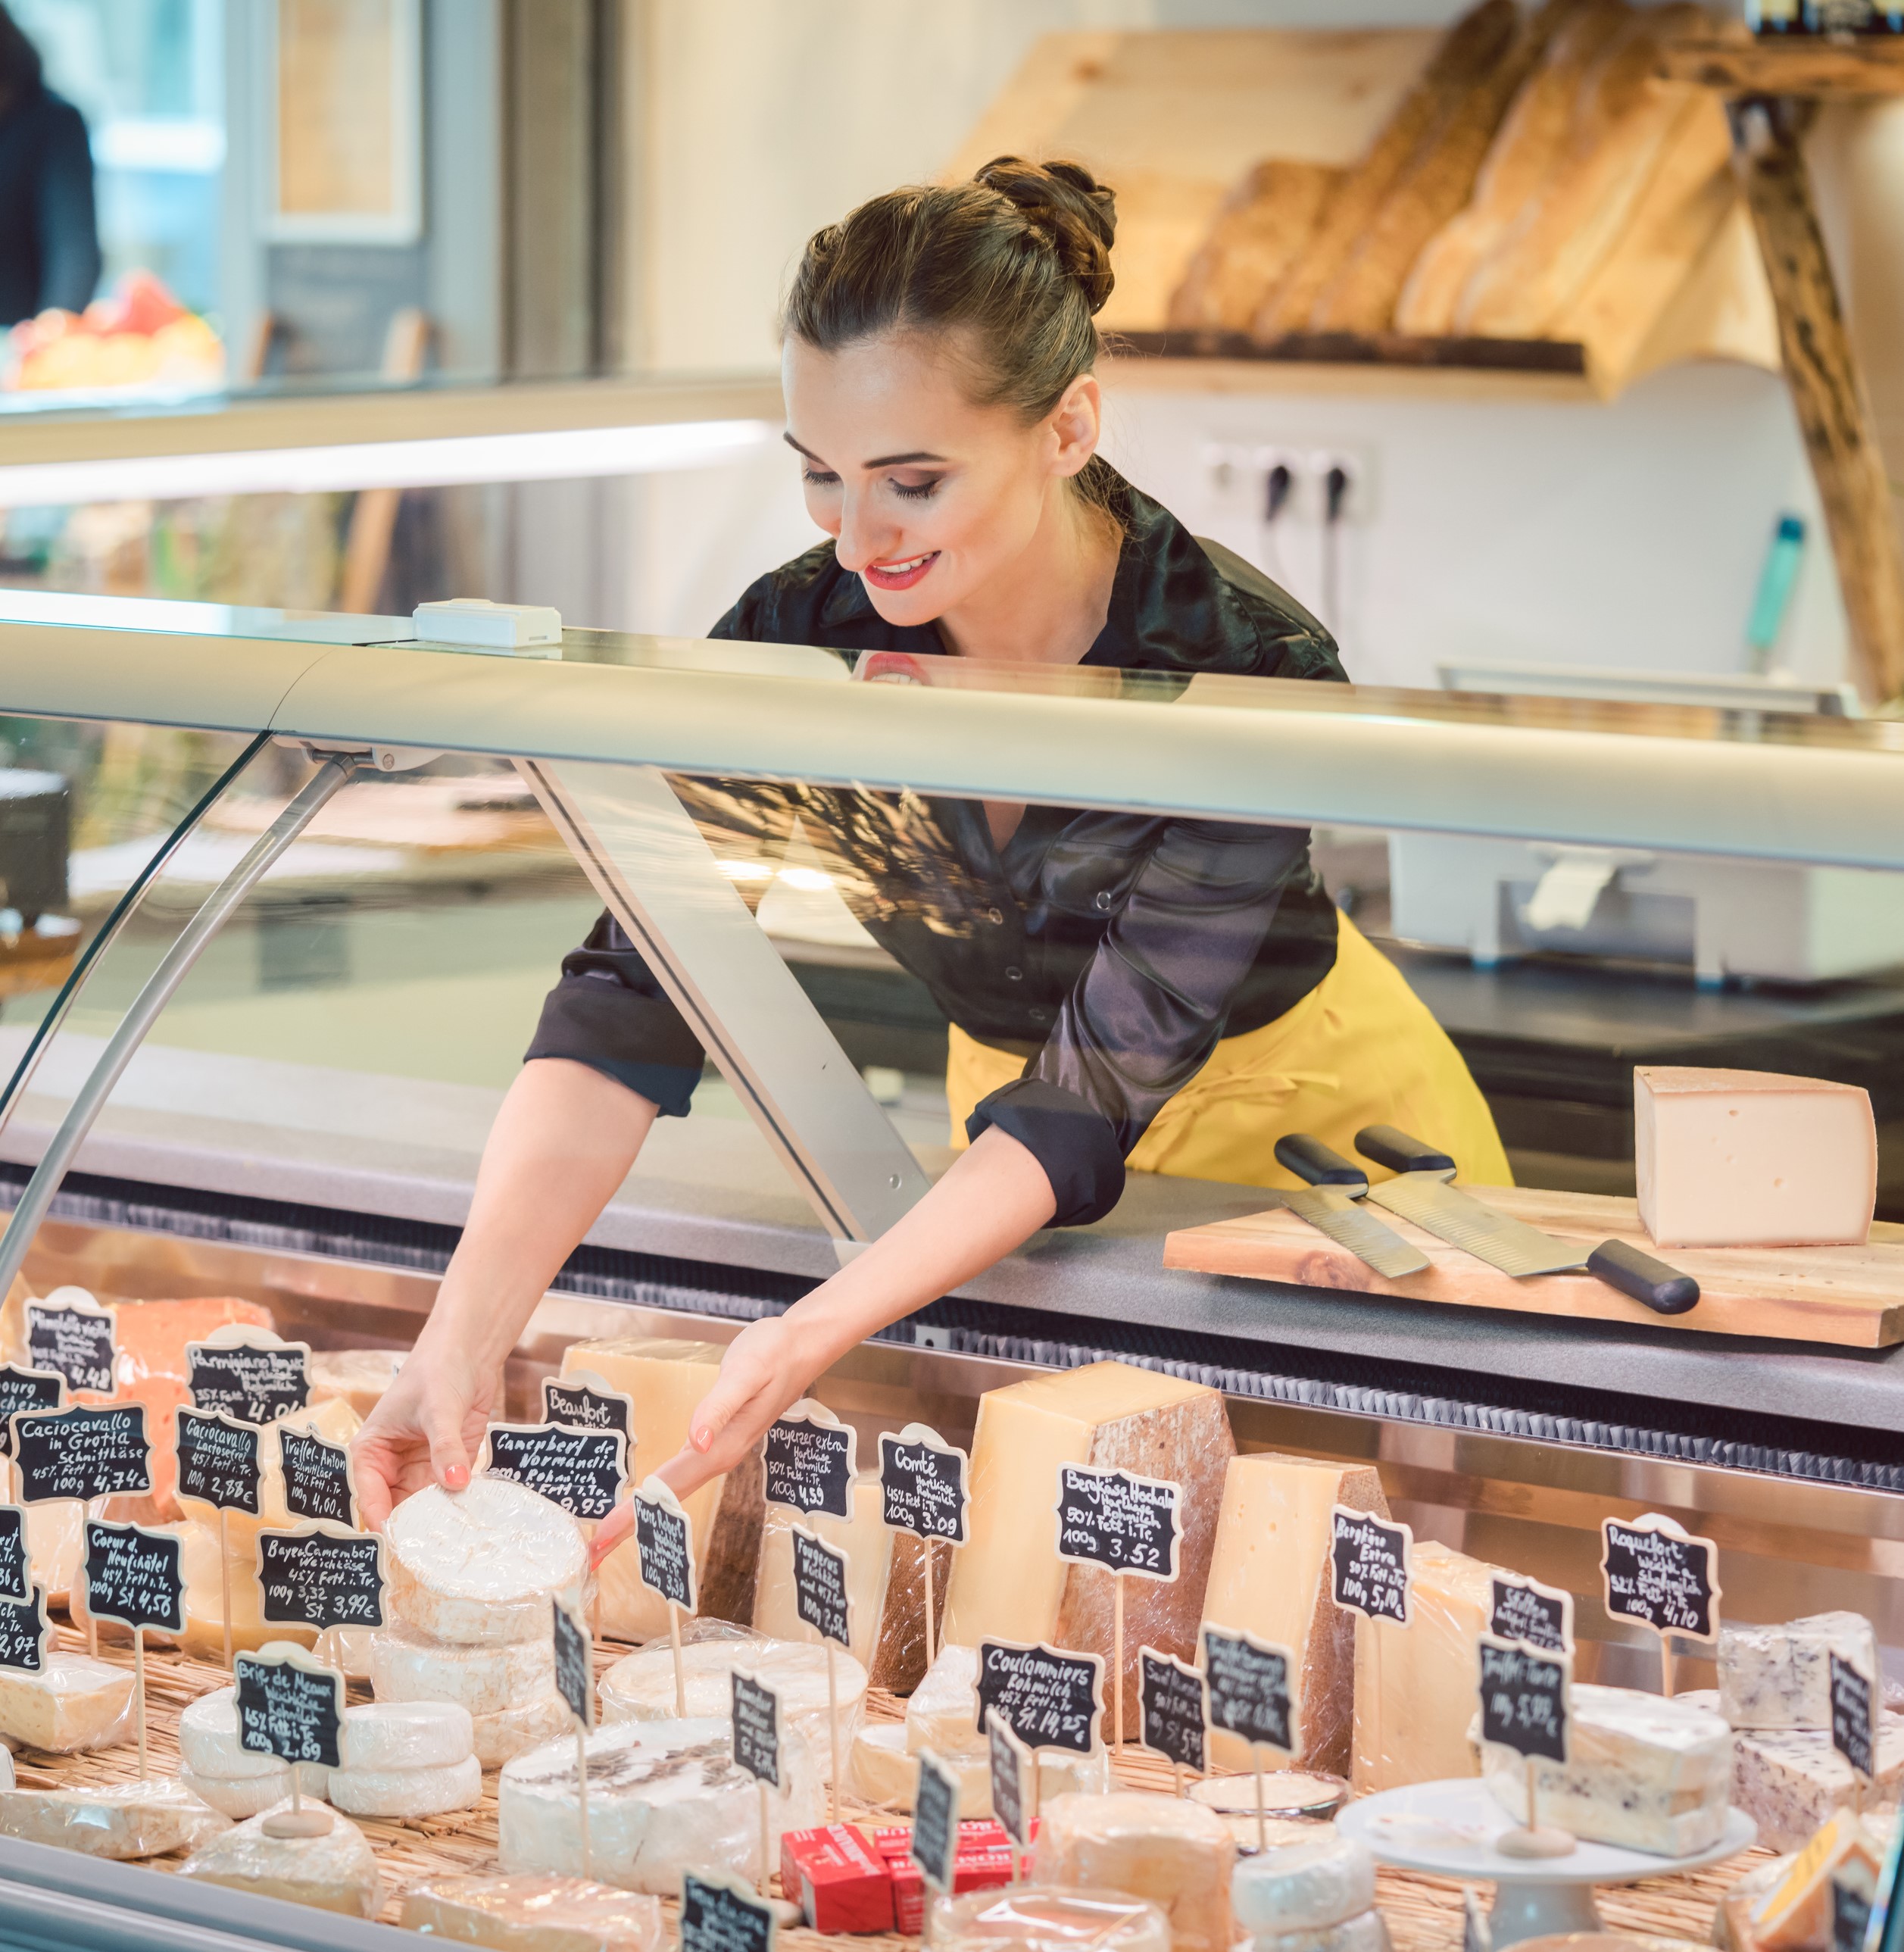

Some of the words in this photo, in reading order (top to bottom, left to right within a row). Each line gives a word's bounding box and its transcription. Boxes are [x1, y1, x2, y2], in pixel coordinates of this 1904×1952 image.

[70, 1365, 111, 1390] 4.48
[0, 1381, 36, 1399] ourg
[550, 1388, 611, 1425] Beaufort
[22, 1412, 131, 1438] Caciocavallo
[186, 1418, 251, 1453] Caciocavallo
[49, 1438, 62, 1451] in
[68, 1432, 130, 1450] Grotta
[196, 1440, 247, 1463] Lactosefrei
[594, 1440, 615, 1454] de
[816, 1432, 847, 1452] extra
[58, 1447, 144, 1464] Schnittkäse
[192, 1452, 210, 1467] 45%
[211, 1457, 230, 1471] Fett
[240, 1464, 251, 1476] Tr.
[519, 1454, 616, 1471] Normandie
[794, 1446, 832, 1464] Hartkäse
[794, 1457, 832, 1473] Rohmilch
[895, 1446, 938, 1477] Comté
[32, 1465, 58, 1479] 45%
[61, 1463, 86, 1476] Fett
[292, 1457, 332, 1480] Schnittkäse
[525, 1469, 596, 1485] Rohmilch
[769, 1461, 785, 1476] 50%
[787, 1466, 804, 1481] Fett
[53, 1477, 84, 1495] 100g
[187, 1469, 204, 1493] 100g
[294, 1472, 308, 1486] 50%
[311, 1476, 325, 1490] Fett
[771, 1480, 796, 1504] 100g
[1066, 1469, 1127, 1504] Bergkäse
[292, 1486, 307, 1510] 100g
[887, 1485, 904, 1504] 45%
[906, 1492, 921, 1508] Fett
[916, 1485, 956, 1508] Rohmilch
[635, 1498, 657, 1528] Pierre
[657, 1508, 683, 1540] Robert
[886, 1504, 915, 1528] 100g
[922, 1511, 957, 1536] 3.09
[1066, 1507, 1095, 1527] 50%
[1096, 1514, 1125, 1535] Fett
[1103, 1504, 1162, 1529] Rohmilch
[92, 1529, 126, 1550] Coeur
[127, 1537, 138, 1554] d.
[1063, 1529, 1097, 1553] 100g
[1110, 1538, 1160, 1568] 3,52
[1608, 1526, 1683, 1561] Roquefort
[299, 1556, 366, 1572] Weichkäse
[1359, 1543, 1397, 1566] Extra
[102, 1567, 123, 1585] 45%
[125, 1571, 148, 1586] Fett
[289, 1568, 316, 1586] 45%
[359, 1573, 376, 1588] Tr.
[645, 1564, 661, 1589] 100g
[90, 1581, 113, 1604] 200g
[117, 1586, 135, 1611] St.
[269, 1585, 293, 1606] 100g
[298, 1585, 327, 1604] 3,32
[1342, 1577, 1367, 1607] 100g
[0, 1602, 16, 1618] ch
[305, 1602, 326, 1620] St.
[804, 1595, 821, 1626] 100g
[1626, 1598, 1653, 1620] 100g
[1663, 1604, 1699, 1629] 4,10
[988, 1648, 1089, 1685] Coulommiers
[238, 1661, 270, 1685] Brie
[273, 1666, 291, 1688] de
[294, 1672, 332, 1697] Meaux
[1007, 1673, 1072, 1698] Rohmilch
[998, 1690, 1022, 1705] 45%
[1023, 1694, 1050, 1707] Fett
[268, 1700, 321, 1726] Rohmilch
[268, 1715, 292, 1738] Fett
[245, 1730, 273, 1754] 100g
[281, 1739, 321, 1761] 2,69
